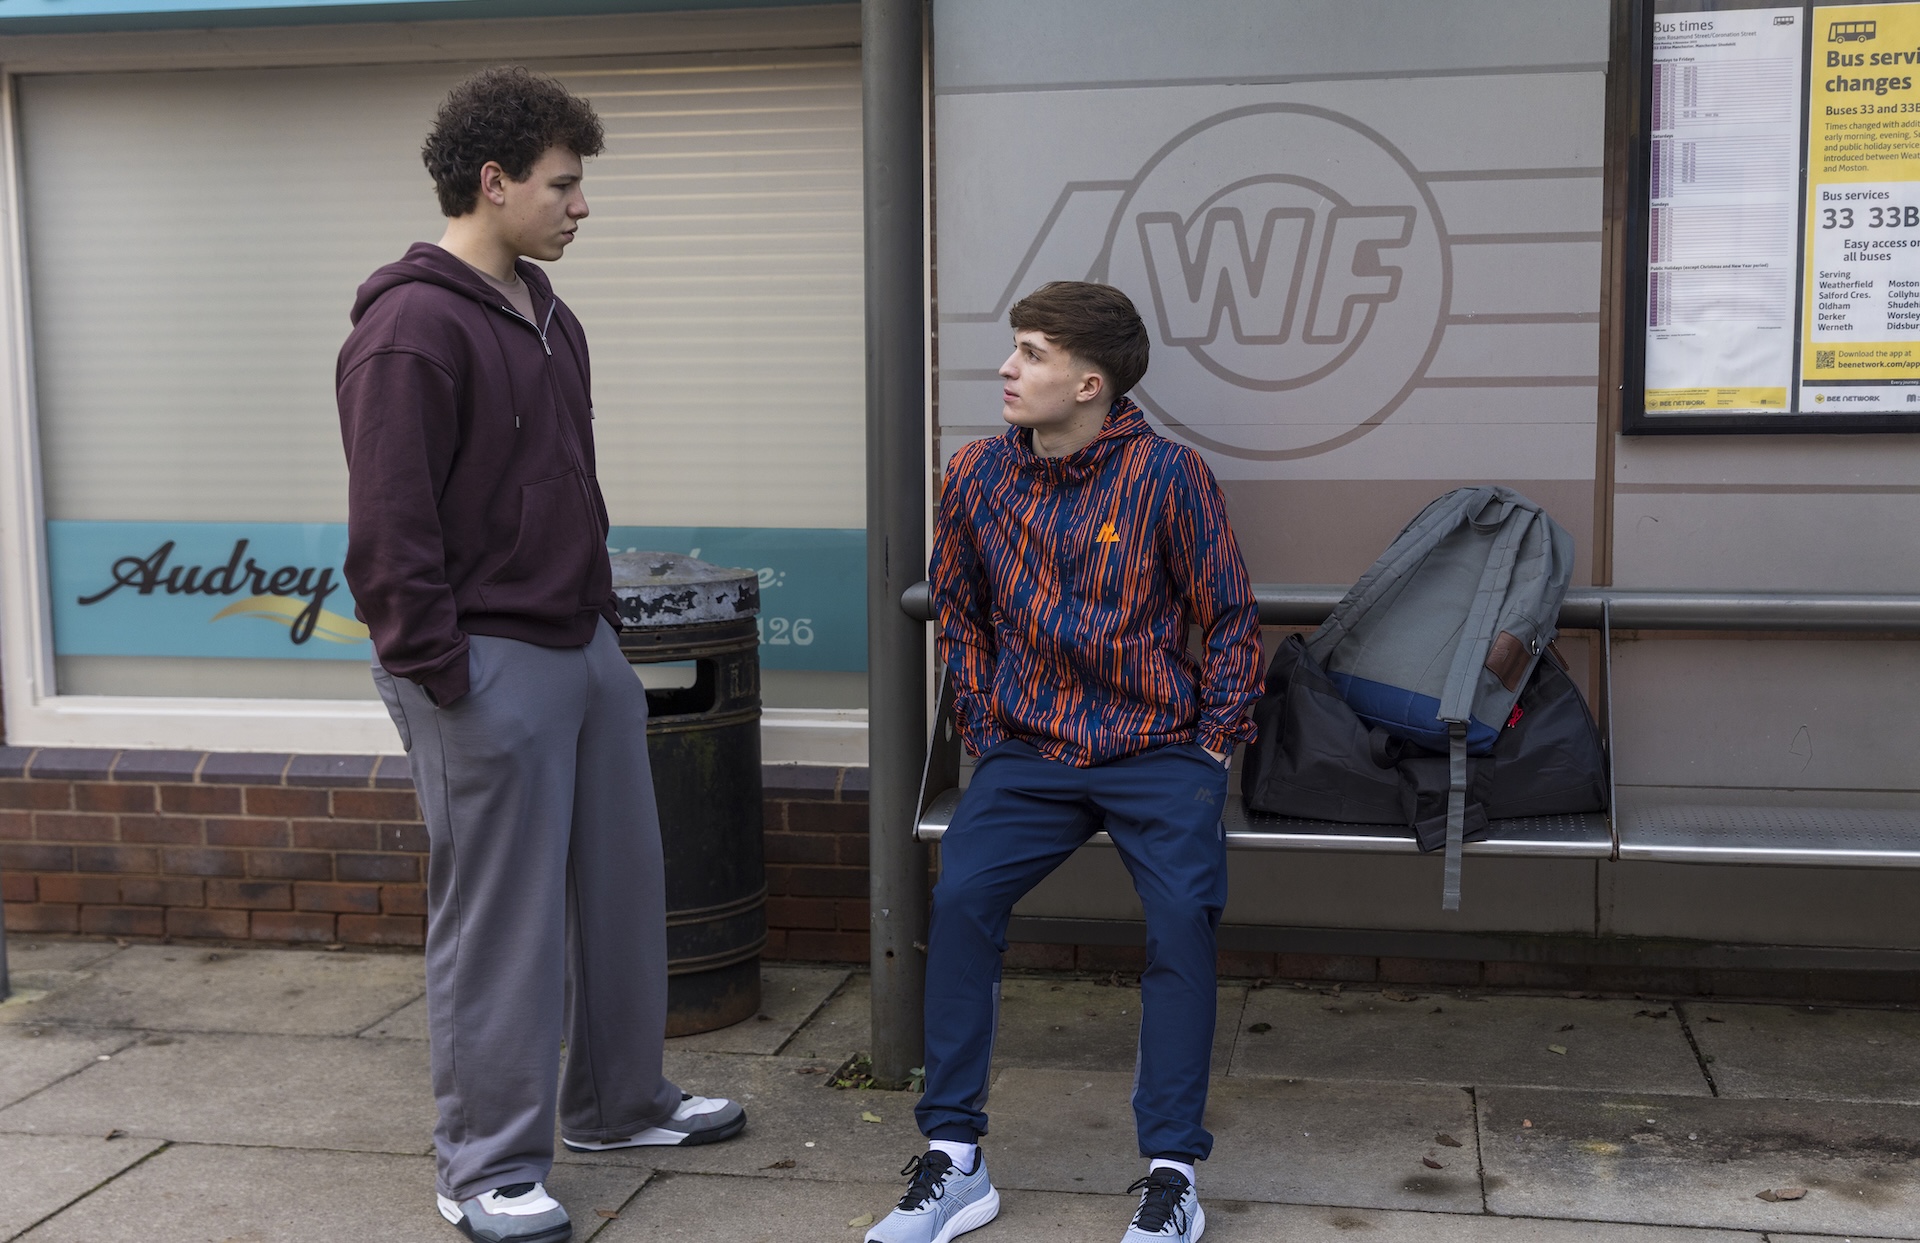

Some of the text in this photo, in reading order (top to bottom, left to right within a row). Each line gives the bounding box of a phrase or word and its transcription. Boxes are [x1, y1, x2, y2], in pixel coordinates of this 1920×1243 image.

[1653, 20, 1714, 33] Bus times
[1694, 31, 1740, 39] Street/Coronation
[1827, 46, 1920, 68] Bus servi
[1825, 74, 1912, 96] changes
[1826, 105, 1858, 116] Buses
[1860, 104, 1875, 114] 33
[1877, 103, 1898, 114] and
[1825, 122, 1848, 130] Times
[1849, 121, 1881, 131] changed
[1883, 120, 1900, 128] with
[1824, 133, 1843, 143] early
[1844, 132, 1878, 142] morning,
[1880, 131, 1911, 140] evening,
[1839, 142, 1862, 152] public
[1863, 142, 1892, 151] holiday
[1893, 141, 1920, 149] service
[1824, 153, 1864, 162] introduced
[1865, 152, 1899, 160] between
[1838, 164, 1869, 172] Moston.
[1822, 190, 1890, 201] Bus services
[1822, 205, 1920, 230] 33 33B
[1843, 239, 1870, 251] Easy
[1872, 239, 1908, 249] access
[1843, 251, 1892, 261] all buses
[1753, 261, 1769, 269] period)
[1136, 205, 1417, 346] WF
[1819, 270, 1851, 280] Serving
[1819, 280, 1874, 289] Weatherfield
[1888, 280, 1920, 288] Moston
[1818, 290, 1872, 300] Salford Cres.
[1888, 290, 1920, 300] Collyhu
[1818, 302, 1851, 310] Oldham
[1818, 313, 1846, 321] Derker
[1887, 311, 1920, 321] Worsley
[1817, 323, 1854, 331] Werneth
[1886, 322, 1920, 331] Didsbur
[1838, 350, 1875, 358] Download
[1889, 350, 1903, 359] app
[1838, 360, 1920, 369] beenetwork.com/app
[77, 538, 340, 645] Audrey
